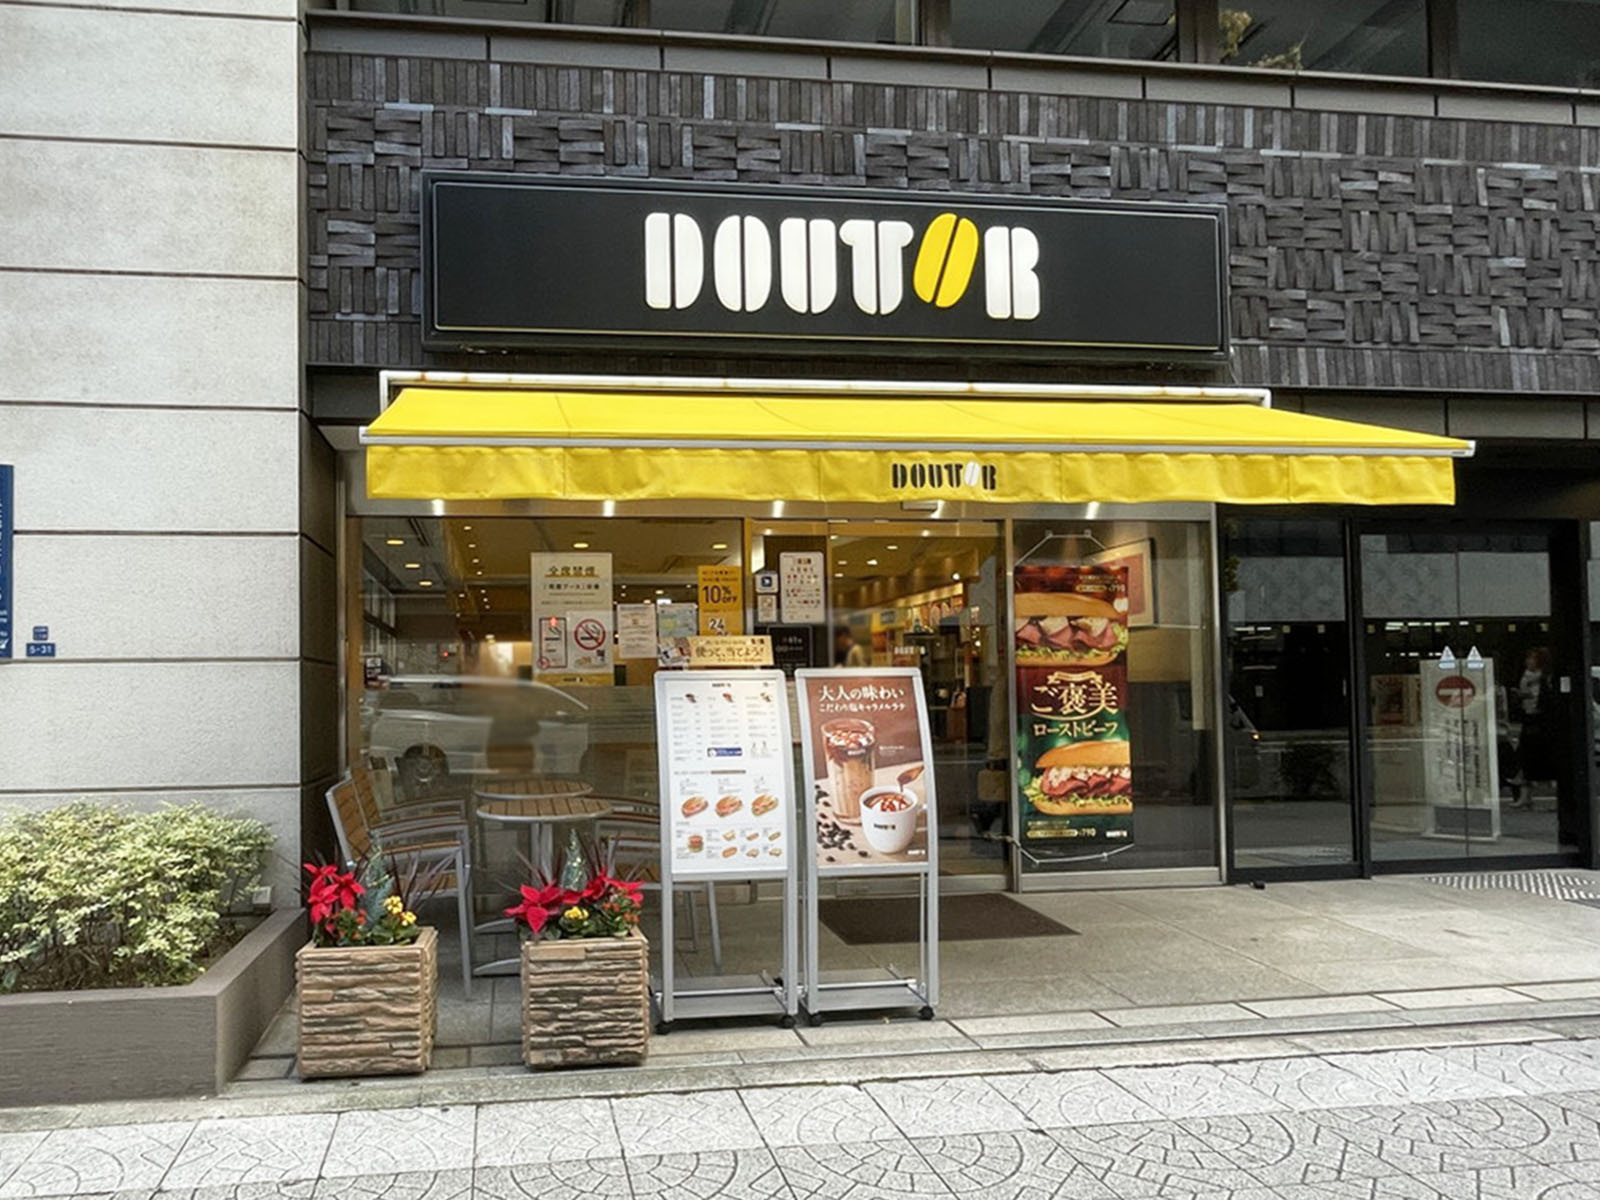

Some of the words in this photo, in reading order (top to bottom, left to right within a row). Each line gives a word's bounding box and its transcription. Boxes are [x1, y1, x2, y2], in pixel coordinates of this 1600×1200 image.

[645, 212, 1041, 320] DOUTOR
[892, 461, 997, 490] DOUTOR
[819, 685, 905, 701] 大人の味わい
[1031, 680, 1119, 718] ご褒美
[1033, 720, 1119, 738] ローストビーフ
